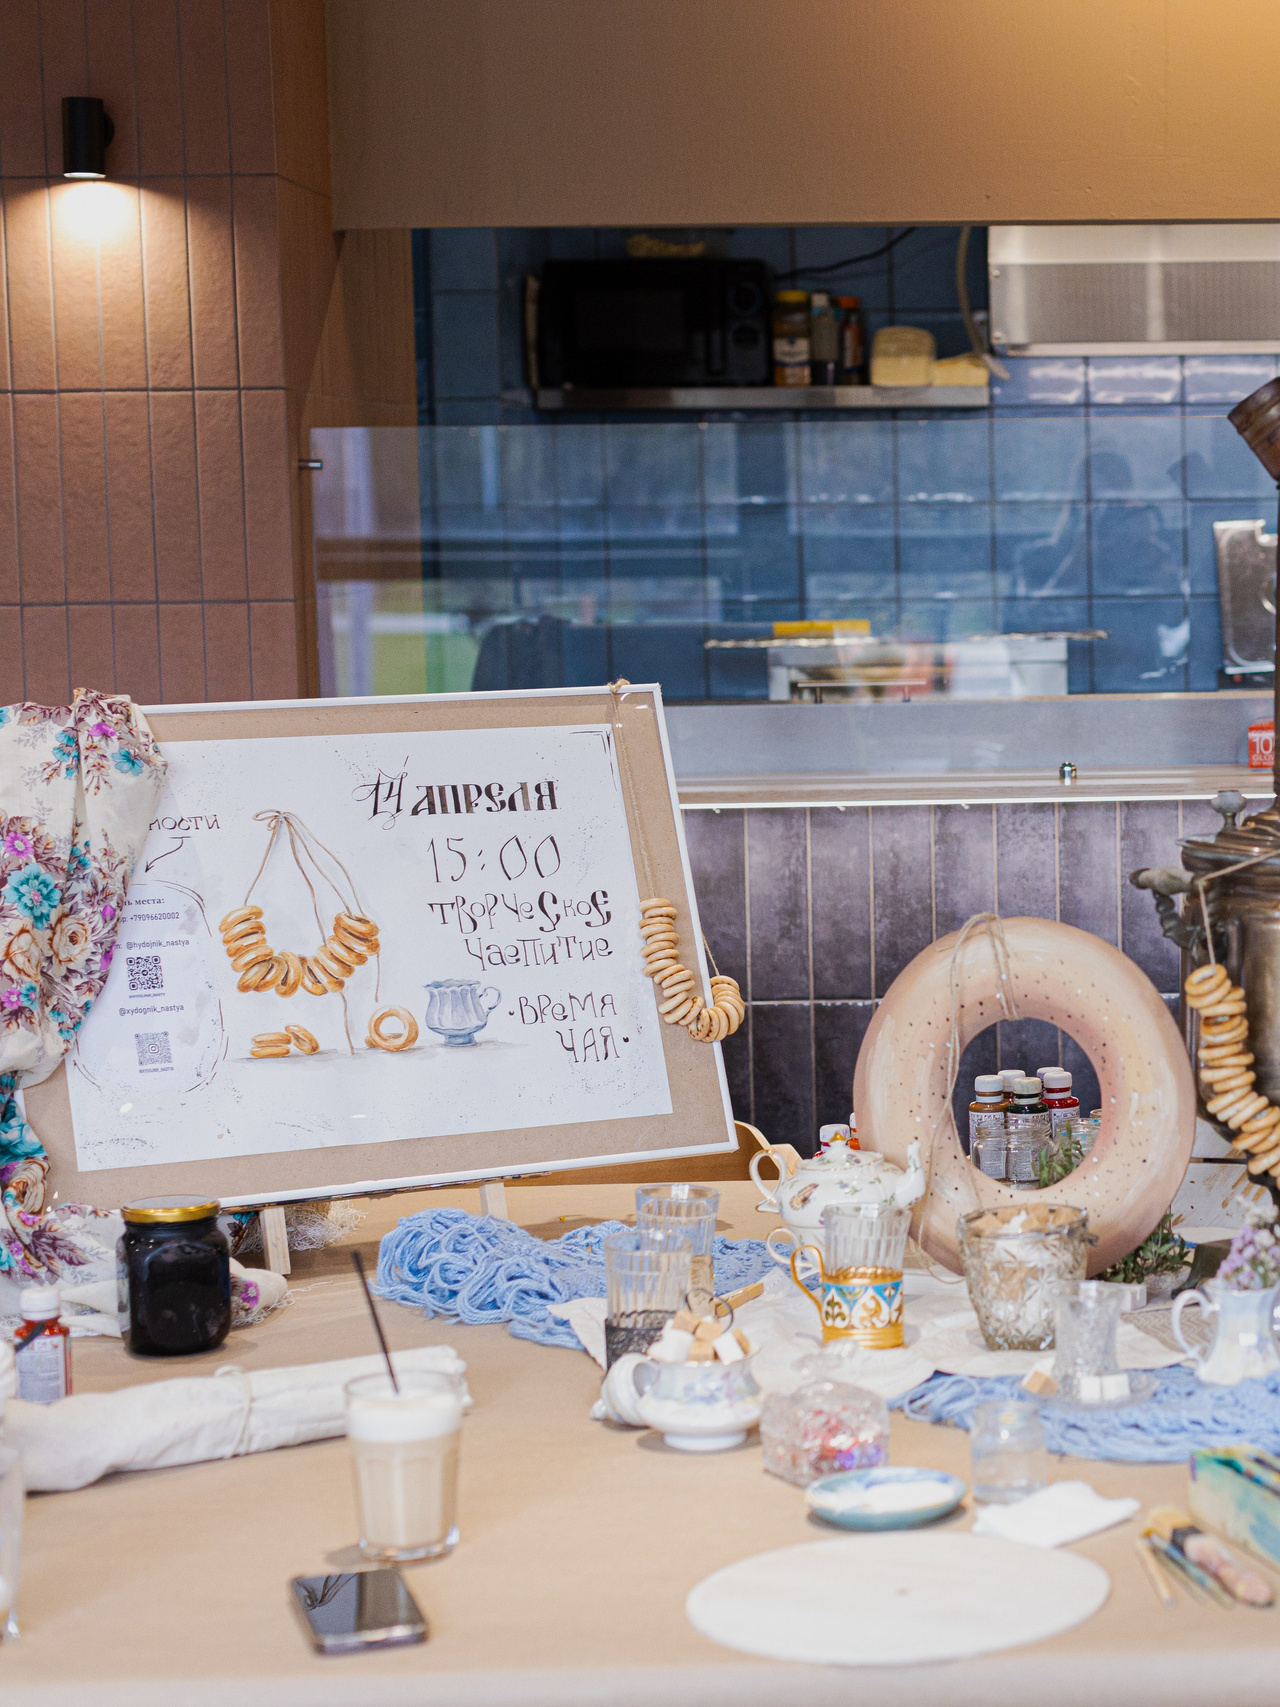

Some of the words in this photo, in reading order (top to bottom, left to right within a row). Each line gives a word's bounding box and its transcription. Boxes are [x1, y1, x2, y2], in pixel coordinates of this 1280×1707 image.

[1252, 735, 1275, 755] 10
[410, 780, 560, 817] АПРЕЛЯ
[426, 833, 561, 883] 15:00
[135, 898, 165, 906] места:
[130, 911, 180, 922] +79096620002
